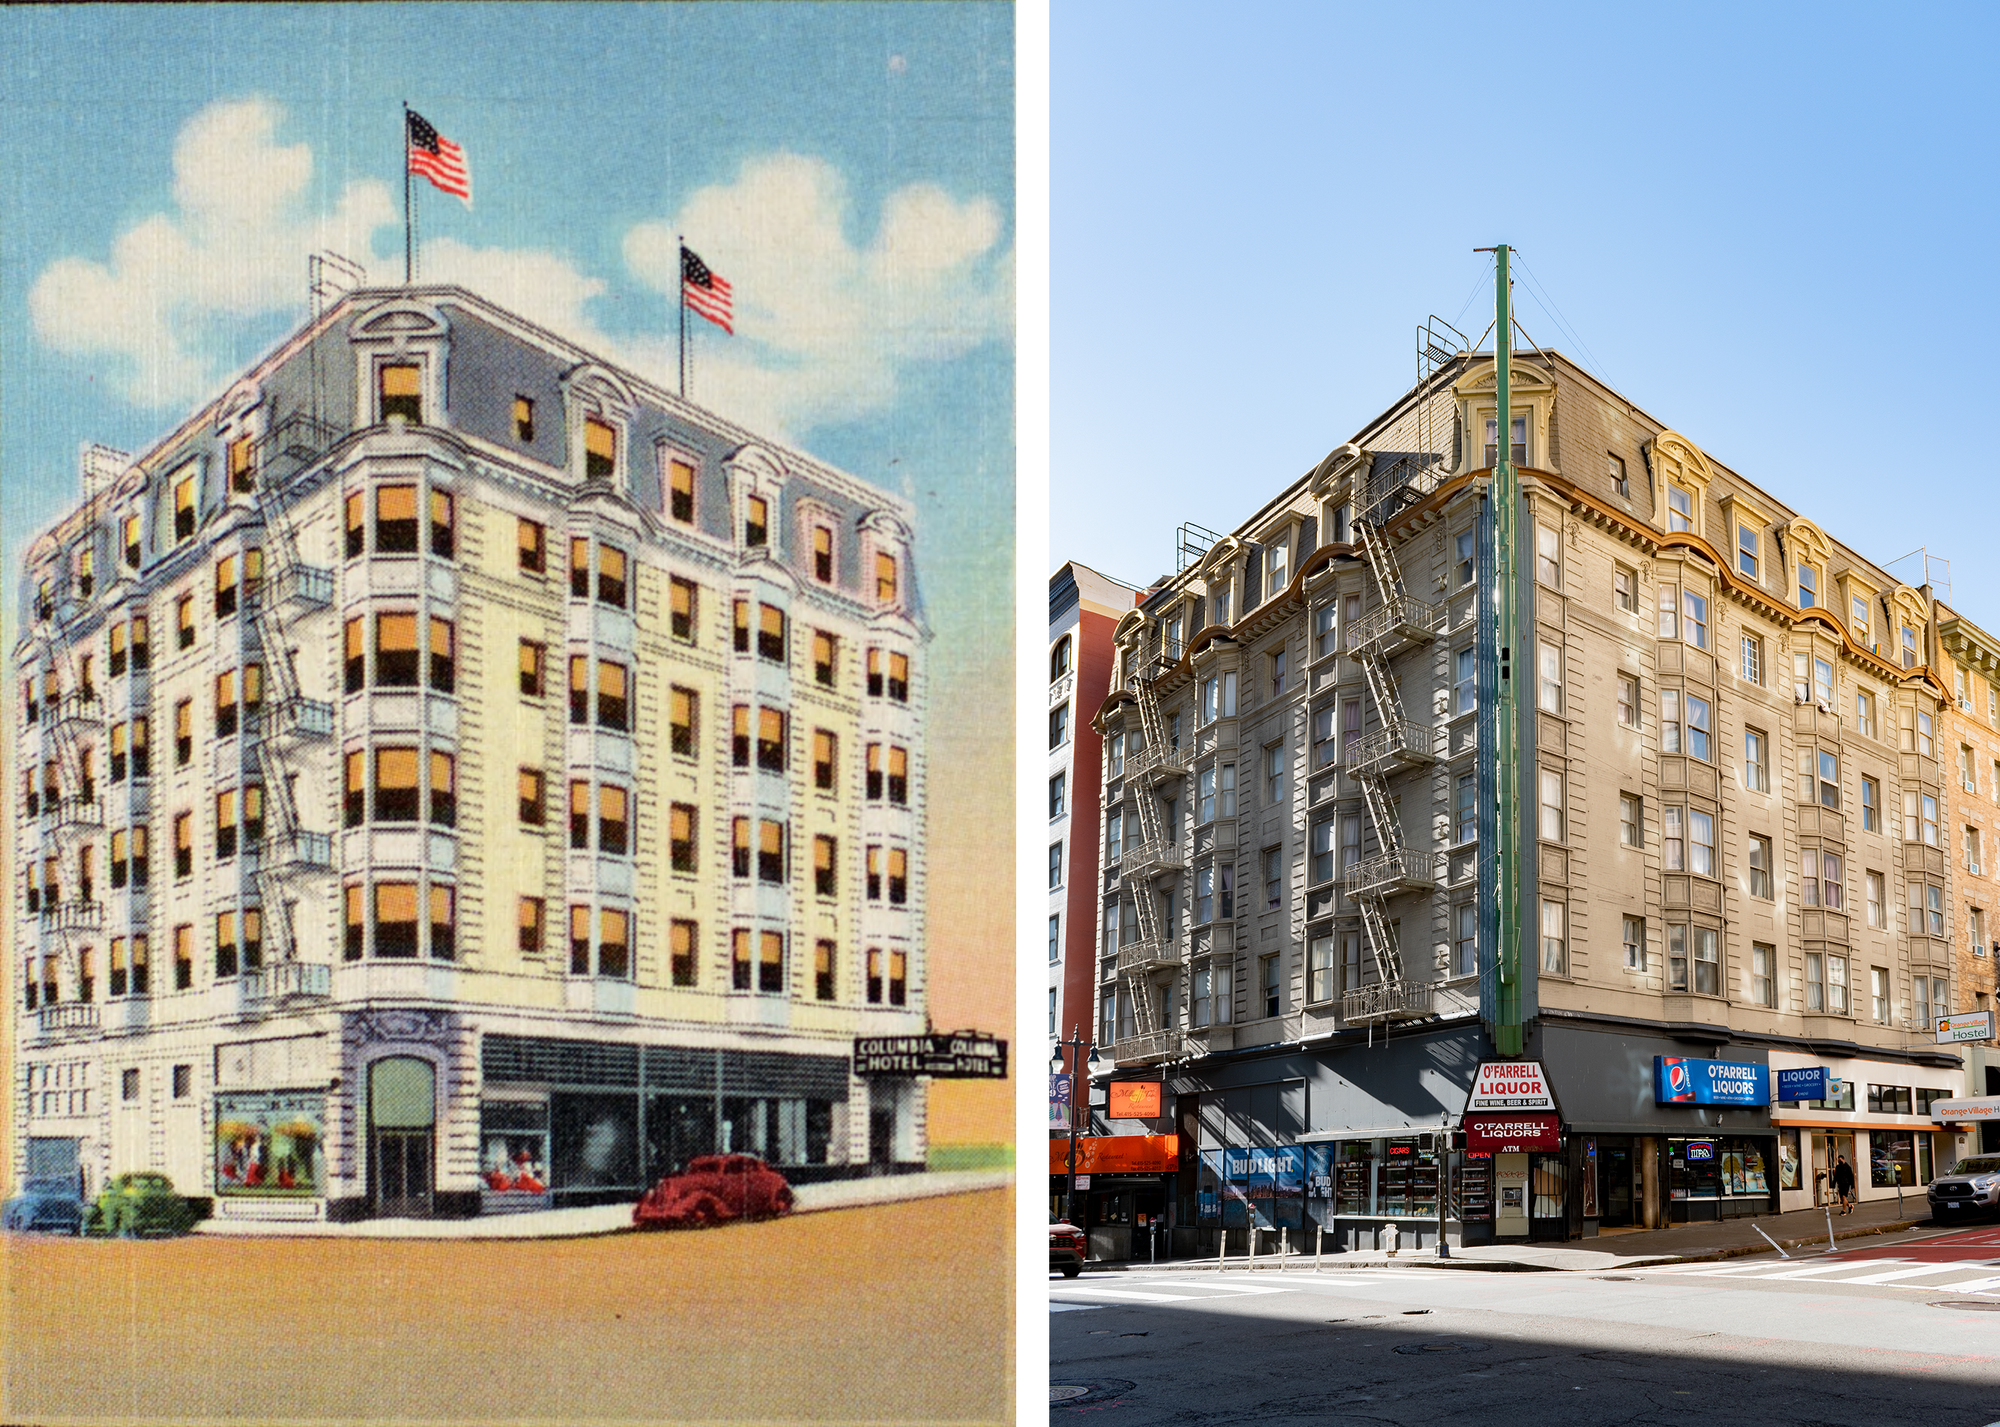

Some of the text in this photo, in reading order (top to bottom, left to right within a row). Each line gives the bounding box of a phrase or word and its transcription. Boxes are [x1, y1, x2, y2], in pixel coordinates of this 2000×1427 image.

[1953, 1027, 1987, 1040] Hostel
[859, 1039, 935, 1054] COLUMBIA
[868, 1055, 922, 1071] HOTEL
[1782, 1070, 1820, 1082] LIQUOR
[1480, 1081, 1542, 1095] LIQUOR
[1712, 1080, 1754, 1095] LIQUORS
[1528, 1098, 1547, 1106] SPIRIT
[1941, 1108, 1968, 1117] Orange
[1967, 1106, 1993, 1116] Village
[1481, 1130, 1541, 1138] LIQUORS
[1389, 1146, 1410, 1155] CIGARS
[1501, 1145, 1520, 1153] ATM
[1232, 1155, 1294, 1175] BUD LIGHT
[1315, 1176, 1332, 1187] BUD
